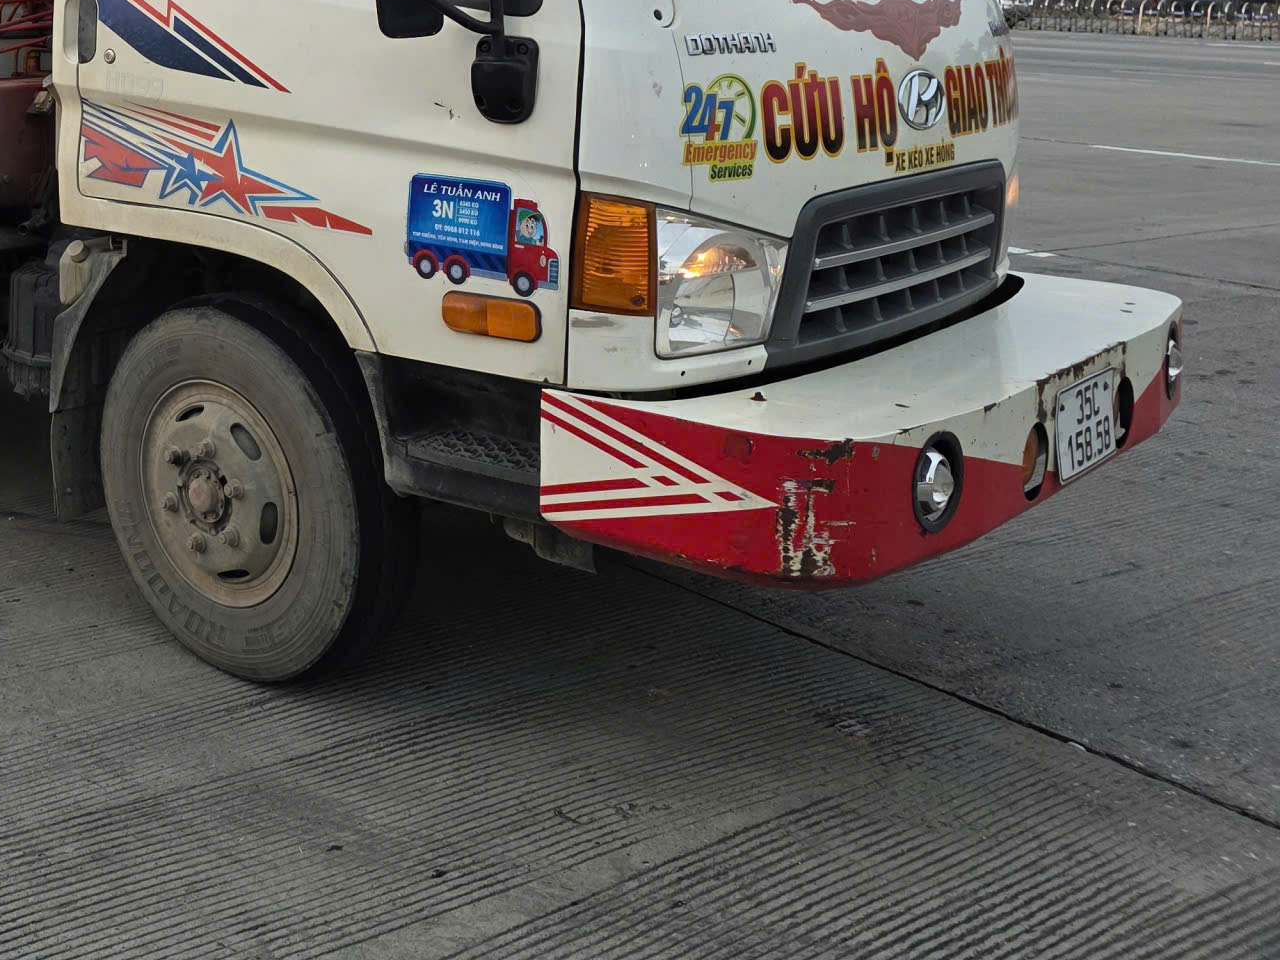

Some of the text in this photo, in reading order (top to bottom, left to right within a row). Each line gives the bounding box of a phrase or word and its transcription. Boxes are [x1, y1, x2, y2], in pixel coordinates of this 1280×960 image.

[684, 31, 777, 56] DOTHANH
[761, 62, 844, 164] CỨU
[851, 57, 899, 166] HỘ
[944, 61, 989, 139] GIAO
[685, 141, 757, 164] Emergency
[895, 152, 906, 172] XE
[925, 147, 935, 167] XE
[710, 163, 753, 181] Services
[424, 182, 500, 202] LÊ TUẤN ANH
[432, 199, 454, 219] 3N
[443, 224, 457, 233] 0988
[458, 226, 469, 235] 812
[469, 227, 480, 237] 116
[1075, 381, 1100, 425] 35C
[1068, 415, 1111, 471] 158.58
